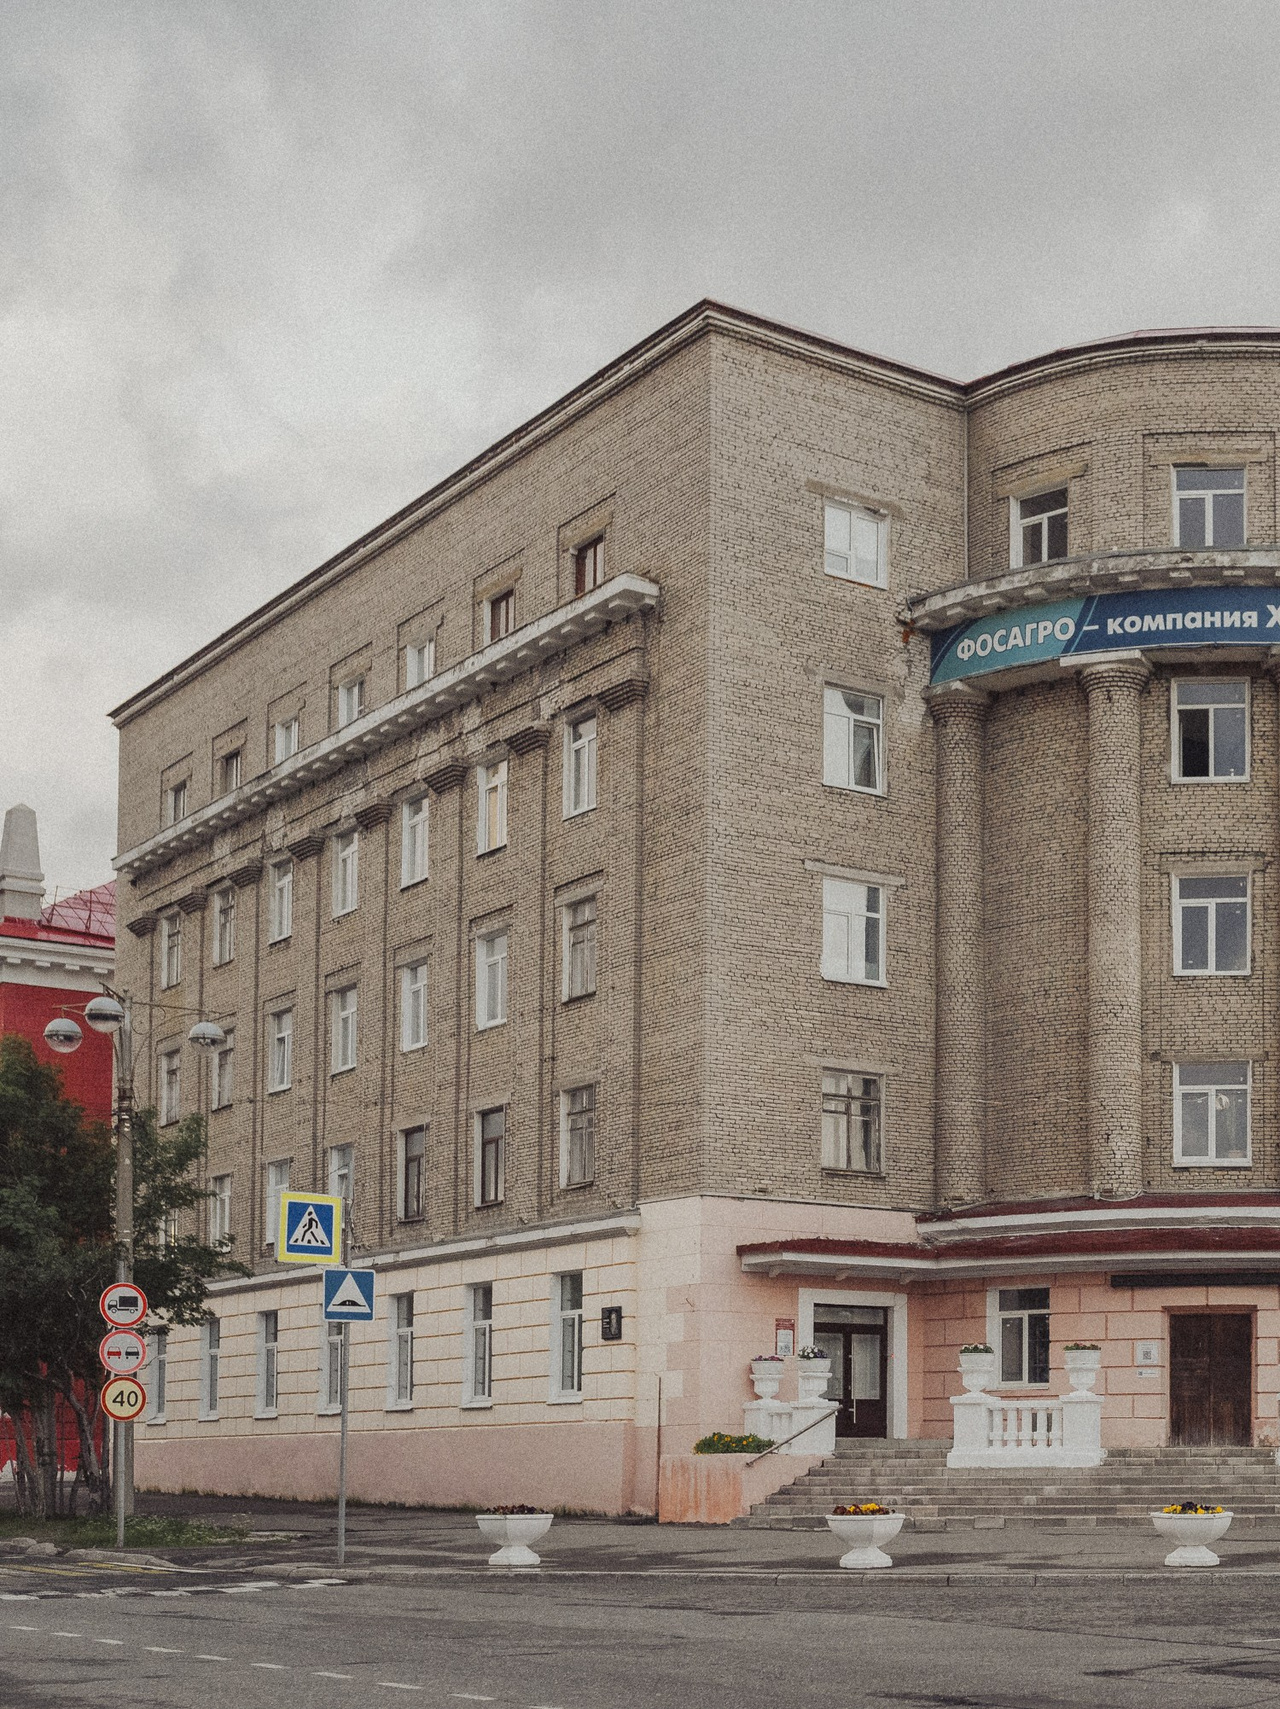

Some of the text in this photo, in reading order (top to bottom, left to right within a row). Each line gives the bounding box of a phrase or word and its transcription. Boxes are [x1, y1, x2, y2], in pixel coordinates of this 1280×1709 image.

[956, 616, 1076, 661] ФОСАГРО
[1107, 611, 1258, 635] компания
[112, 1390, 138, 1407] 40
